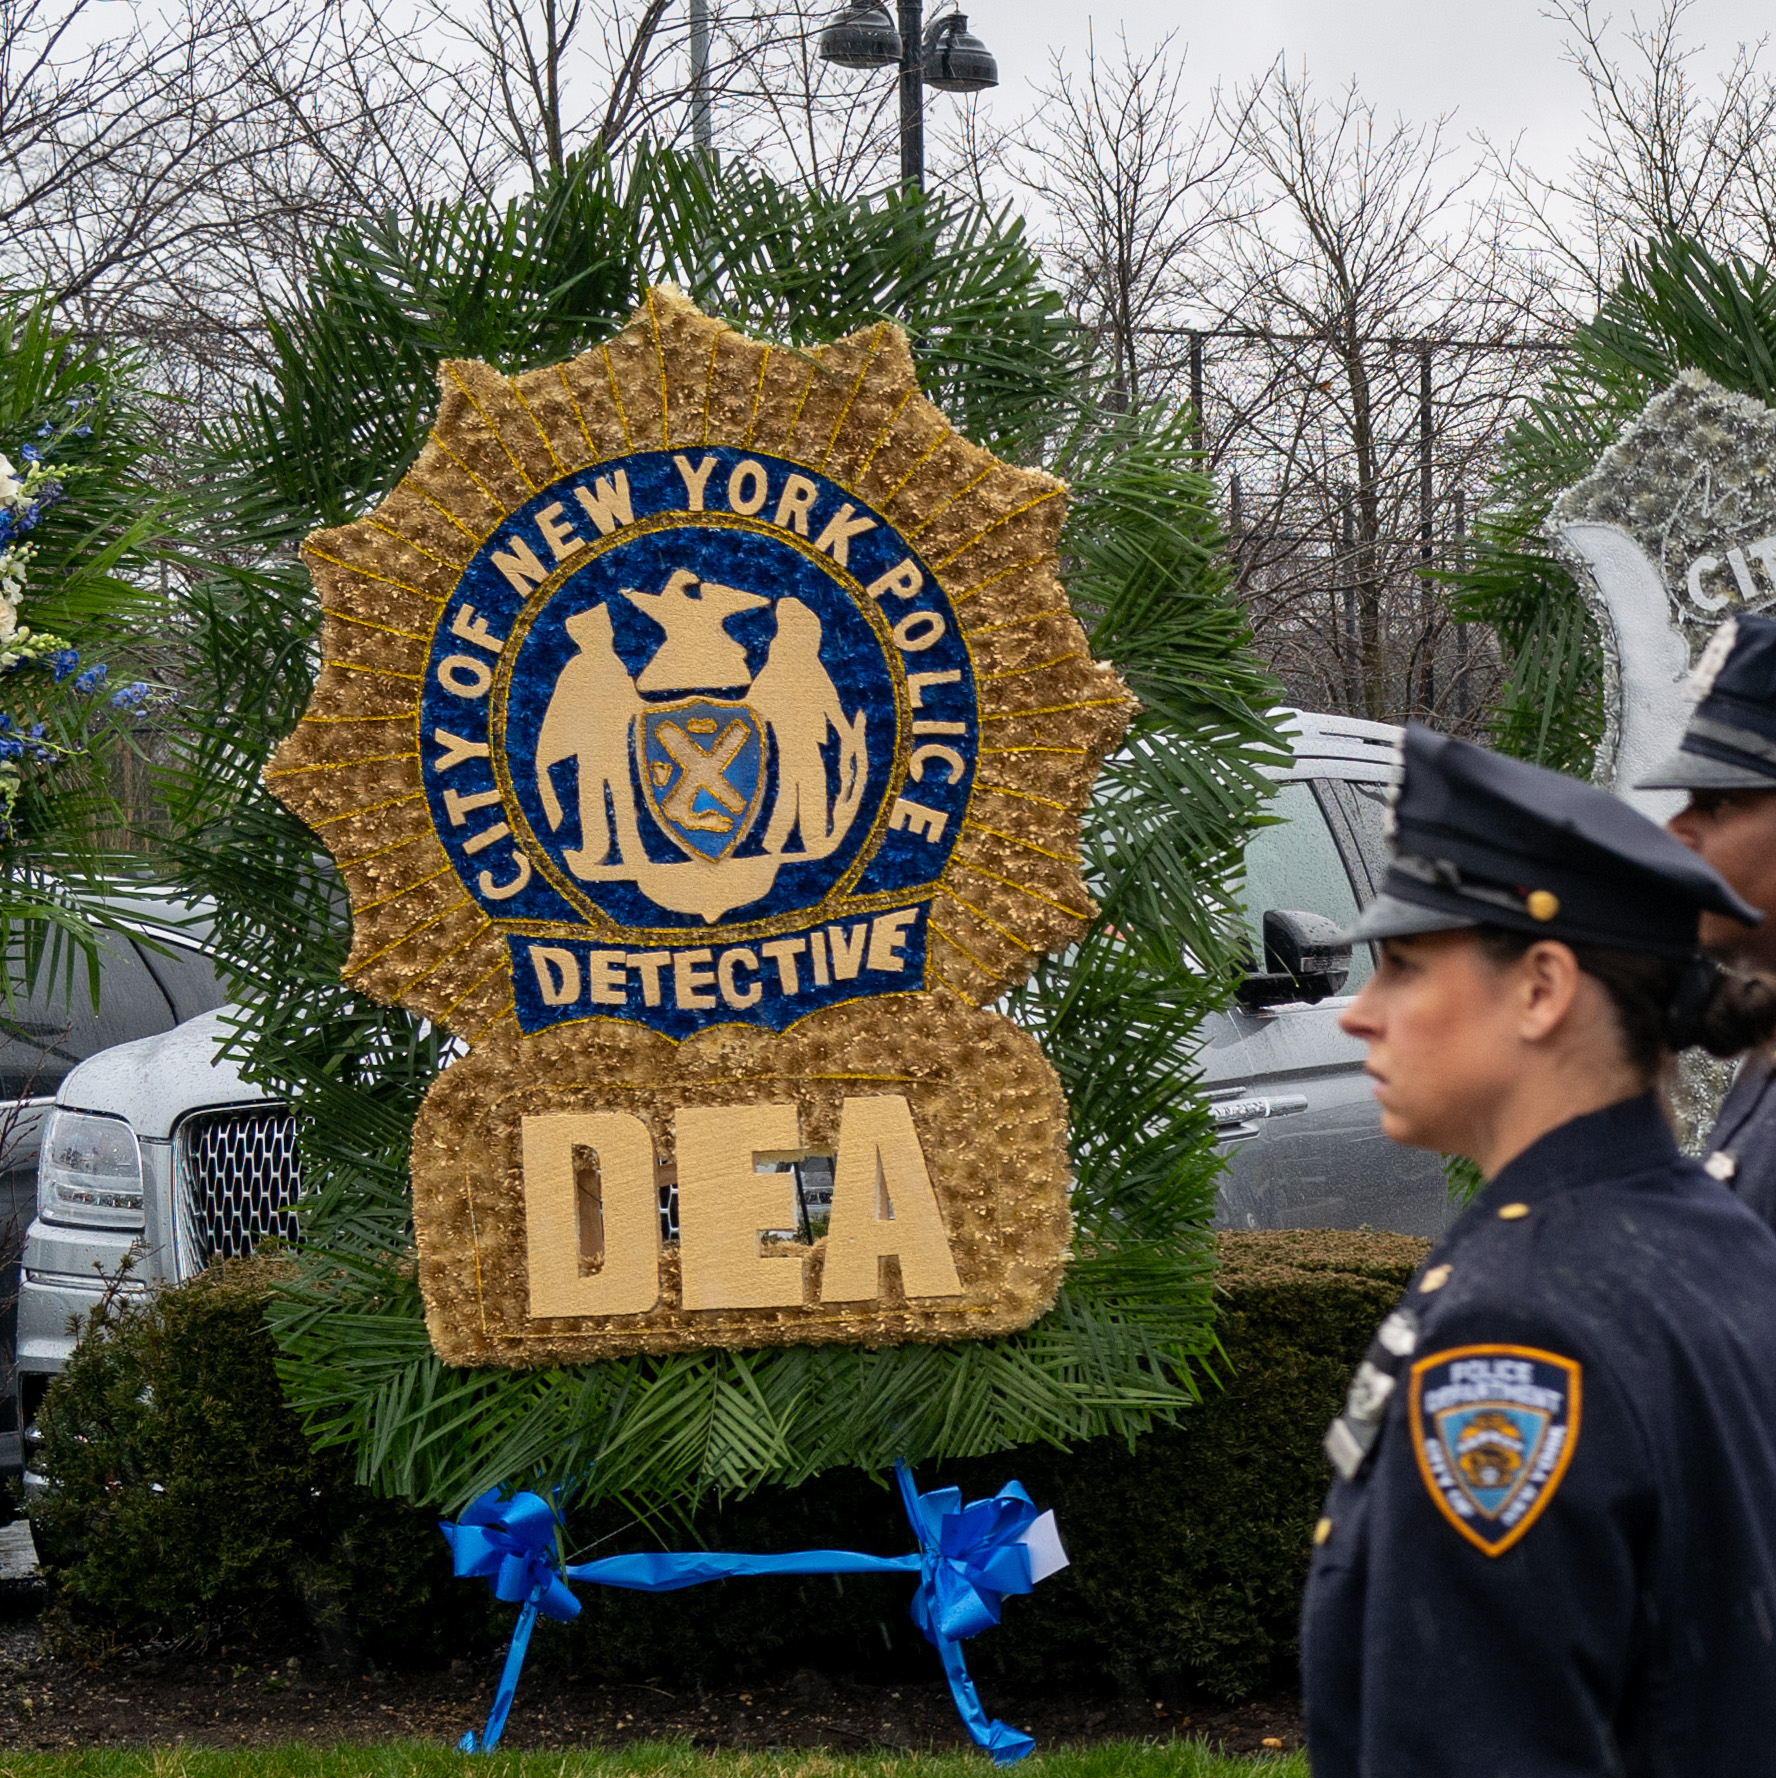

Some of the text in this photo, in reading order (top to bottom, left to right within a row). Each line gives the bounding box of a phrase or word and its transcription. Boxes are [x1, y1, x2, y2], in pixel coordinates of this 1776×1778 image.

[434, 454, 966, 901] CITY OF NEW YORK POLICE
[530, 908, 922, 1010] DETECTIVE
[520, 1094, 966, 1318] DEA
[1449, 1358, 1535, 1385] POLICE
